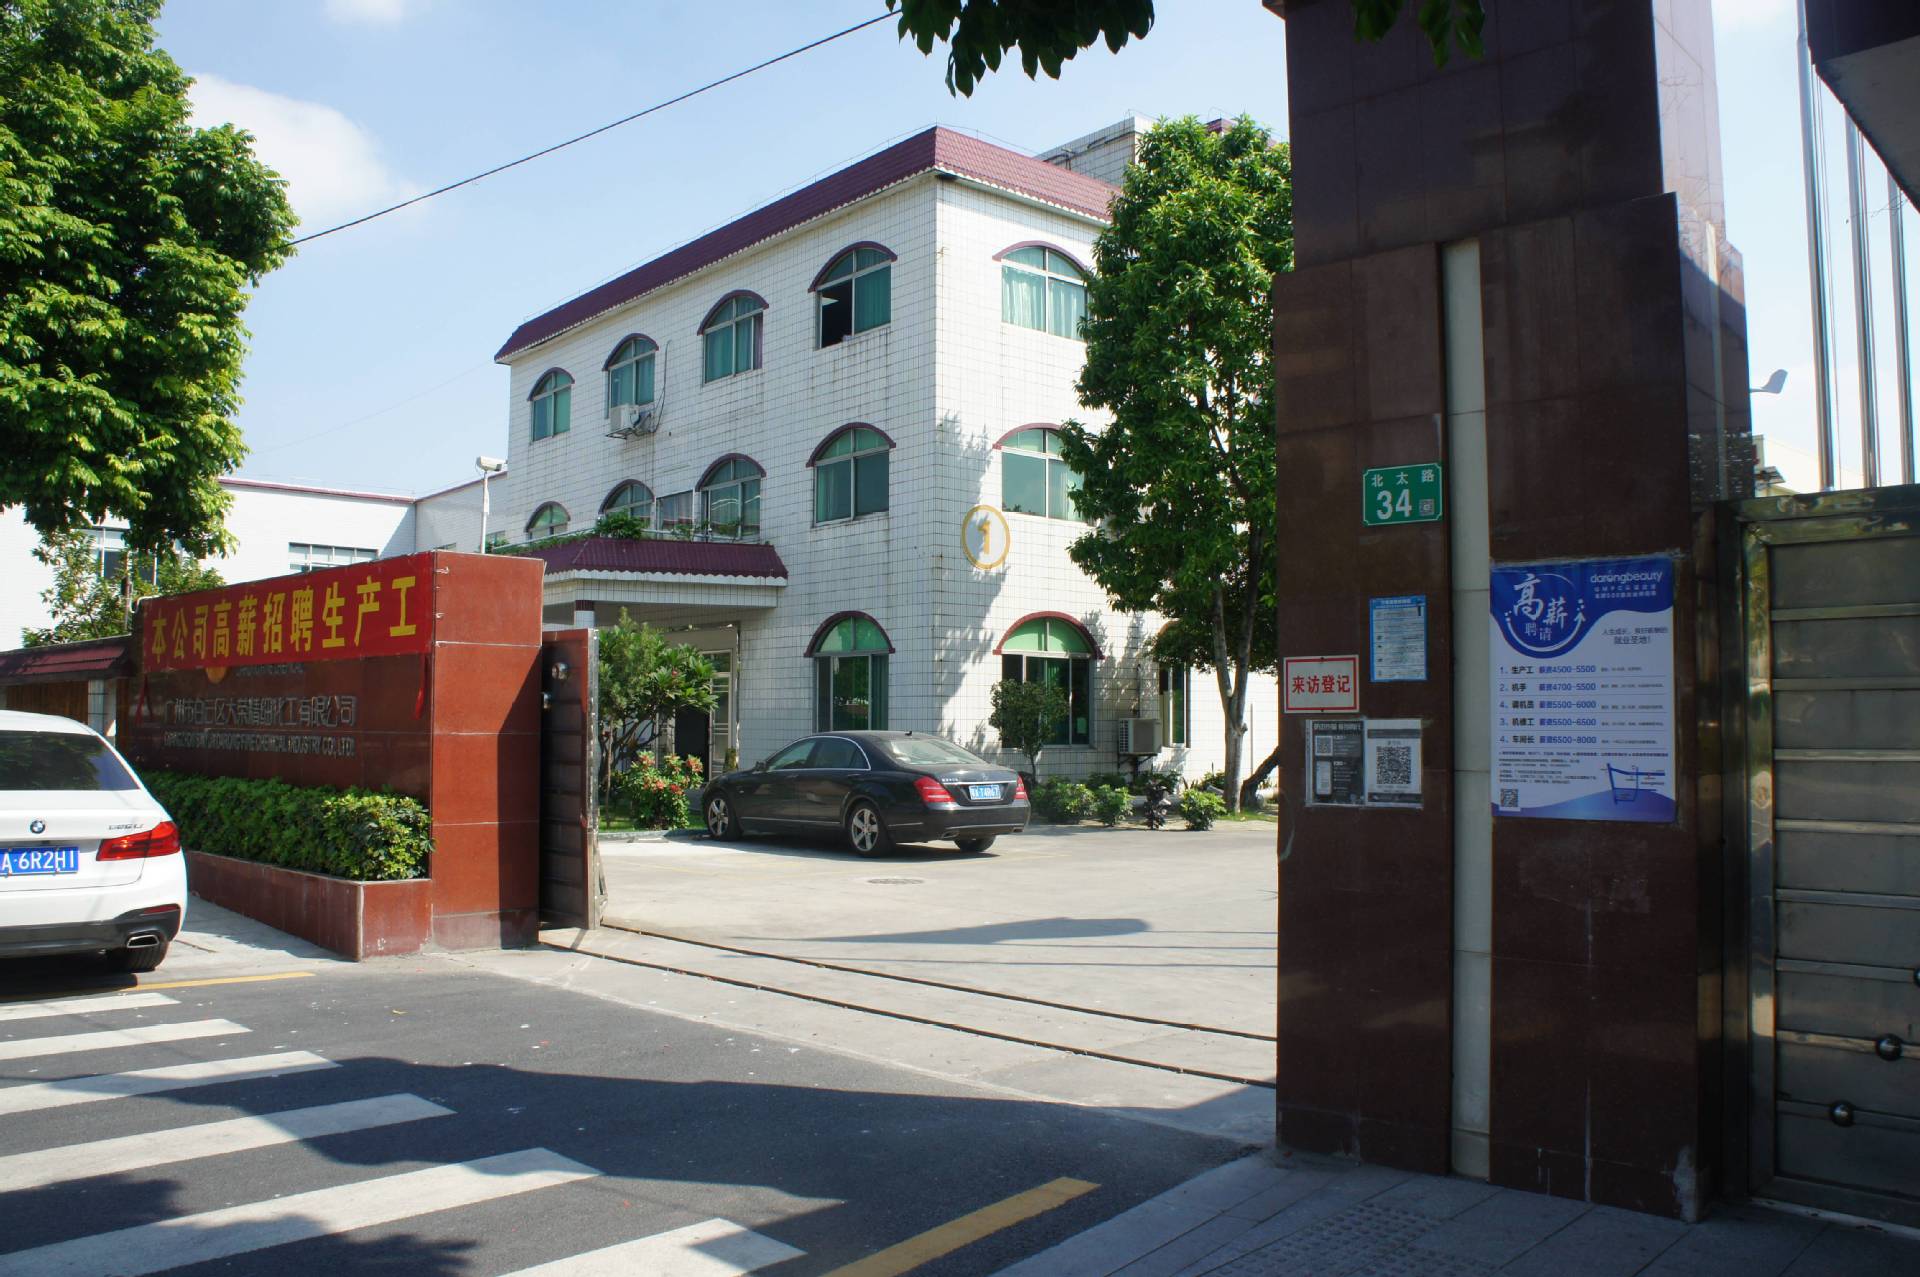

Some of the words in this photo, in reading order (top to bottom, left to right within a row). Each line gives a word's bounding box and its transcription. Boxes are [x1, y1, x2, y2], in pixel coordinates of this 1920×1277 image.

[1371, 469, 1435, 487] 北太路
[1376, 488, 1412, 519] 34
[1590, 571, 1663, 585] darongbeauty
[1513, 574, 1568, 629] 高薪
[152, 575, 417, 662] 本公司高薪招聘生产工
[1511, 665, 1534, 674] 生产工
[1292, 674, 1351, 694] 来访登记
[1511, 683, 1526, 691] 机手
[288, 735, 321, 754] INDUSTRY
[1511, 735, 1534, 744] 车间长
